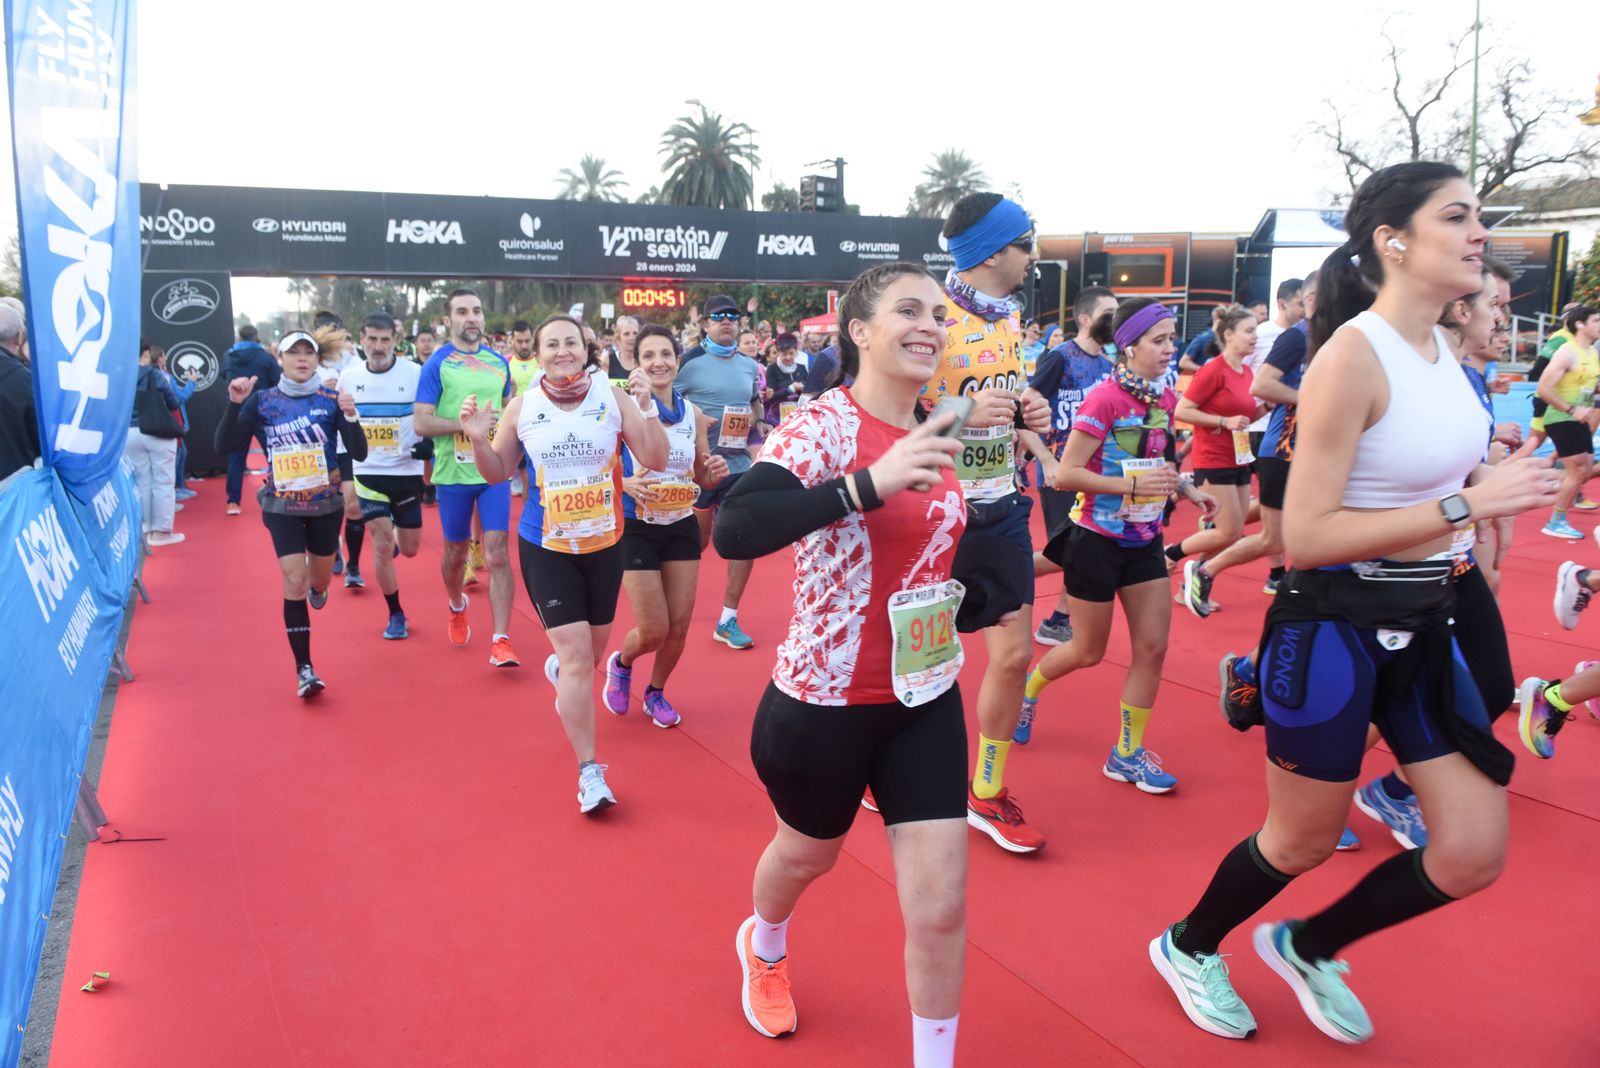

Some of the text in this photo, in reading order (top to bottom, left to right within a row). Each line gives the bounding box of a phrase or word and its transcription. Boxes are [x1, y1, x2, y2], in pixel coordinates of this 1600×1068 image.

[36, 4, 66, 82] FLY
[66, 0, 98, 93] HUM
[281, 220, 347, 234] HYUNDAI
[386, 219, 465, 245] HOKA
[628, 225, 710, 245] maratón
[325, 235, 347, 243] Motor
[757, 234, 817, 256] HOKA
[858, 242, 900, 252] HYUNDAI
[537, 253, 559, 261] Partner
[646, 240, 712, 260] sevilla
[636, 262, 697, 273] 28 enero 2024
[41, 105, 121, 456] HOKA
[623, 288, 686, 307] 00:04:51
[1057, 388, 1082, 402] MEDIO
[541, 451, 566, 460] DON
[570, 449, 606, 457] LUCIO
[552, 442, 594, 451] MONTE
[963, 443, 1005, 467] 6949
[277, 454, 317, 472] 11512
[552, 488, 604, 513] 12864
[15, 503, 80, 624] HOKA
[1272, 626, 1301, 698] WONG
